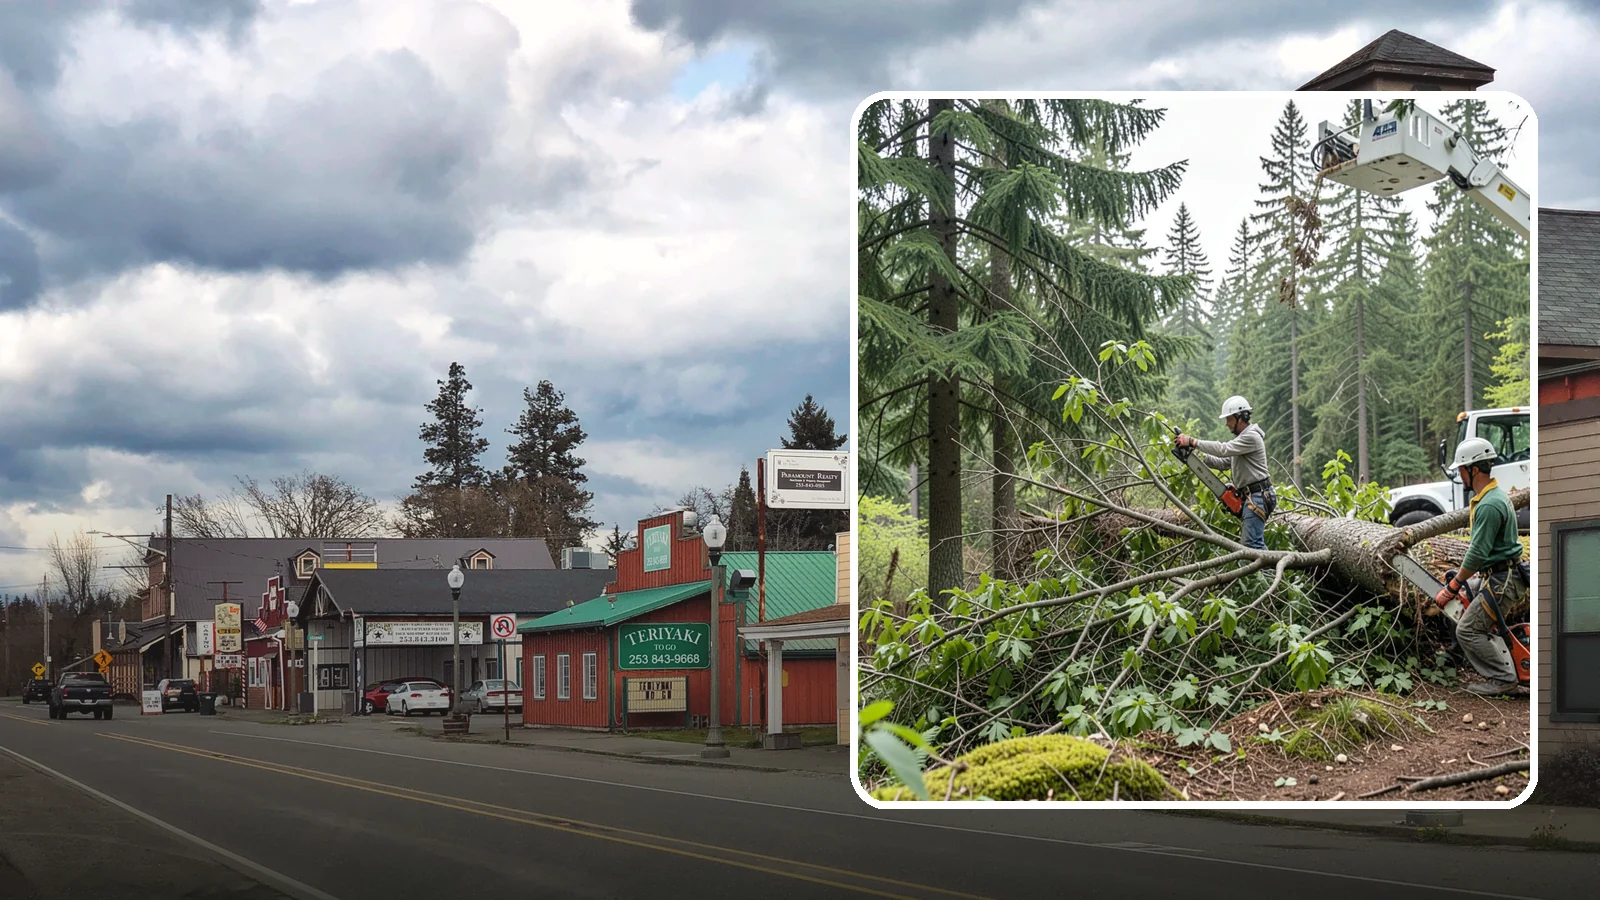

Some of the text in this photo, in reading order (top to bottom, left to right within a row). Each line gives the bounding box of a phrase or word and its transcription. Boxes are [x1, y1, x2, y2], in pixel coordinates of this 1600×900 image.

[781, 471, 839, 480] PARAMOUNT REALTY
[625, 627, 702, 646] TERIYAKI
[653, 643, 677, 651] TO GO
[628, 653, 700, 665] 253 843-9668
